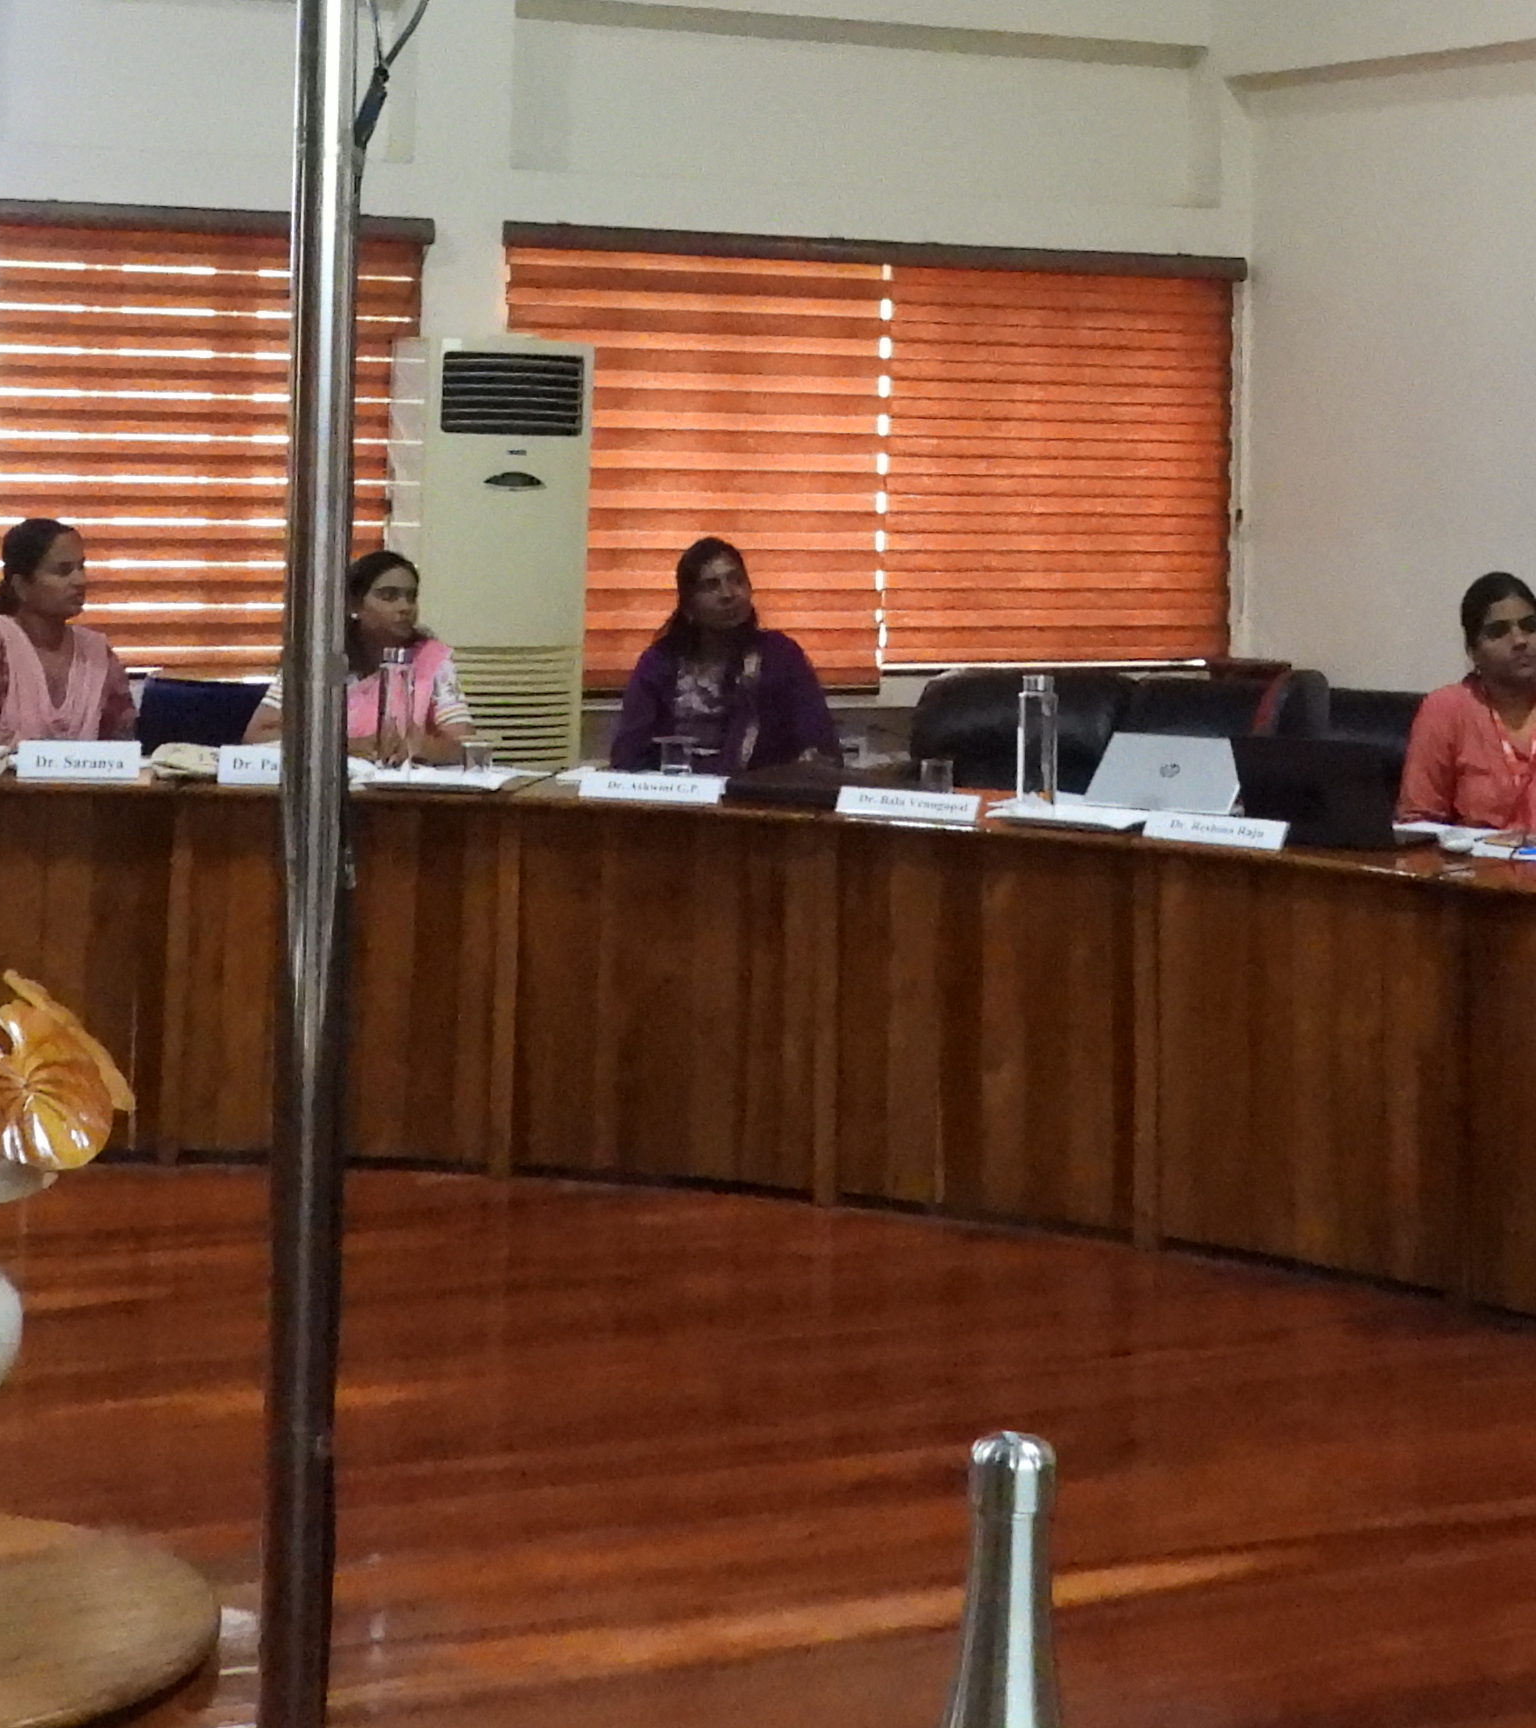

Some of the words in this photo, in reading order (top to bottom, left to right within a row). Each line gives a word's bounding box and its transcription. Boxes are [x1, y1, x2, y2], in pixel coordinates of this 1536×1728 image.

[35, 755, 58, 769] Dr.
[63, 756, 125, 772] Saranya
[233, 757, 255, 770] Dr.
